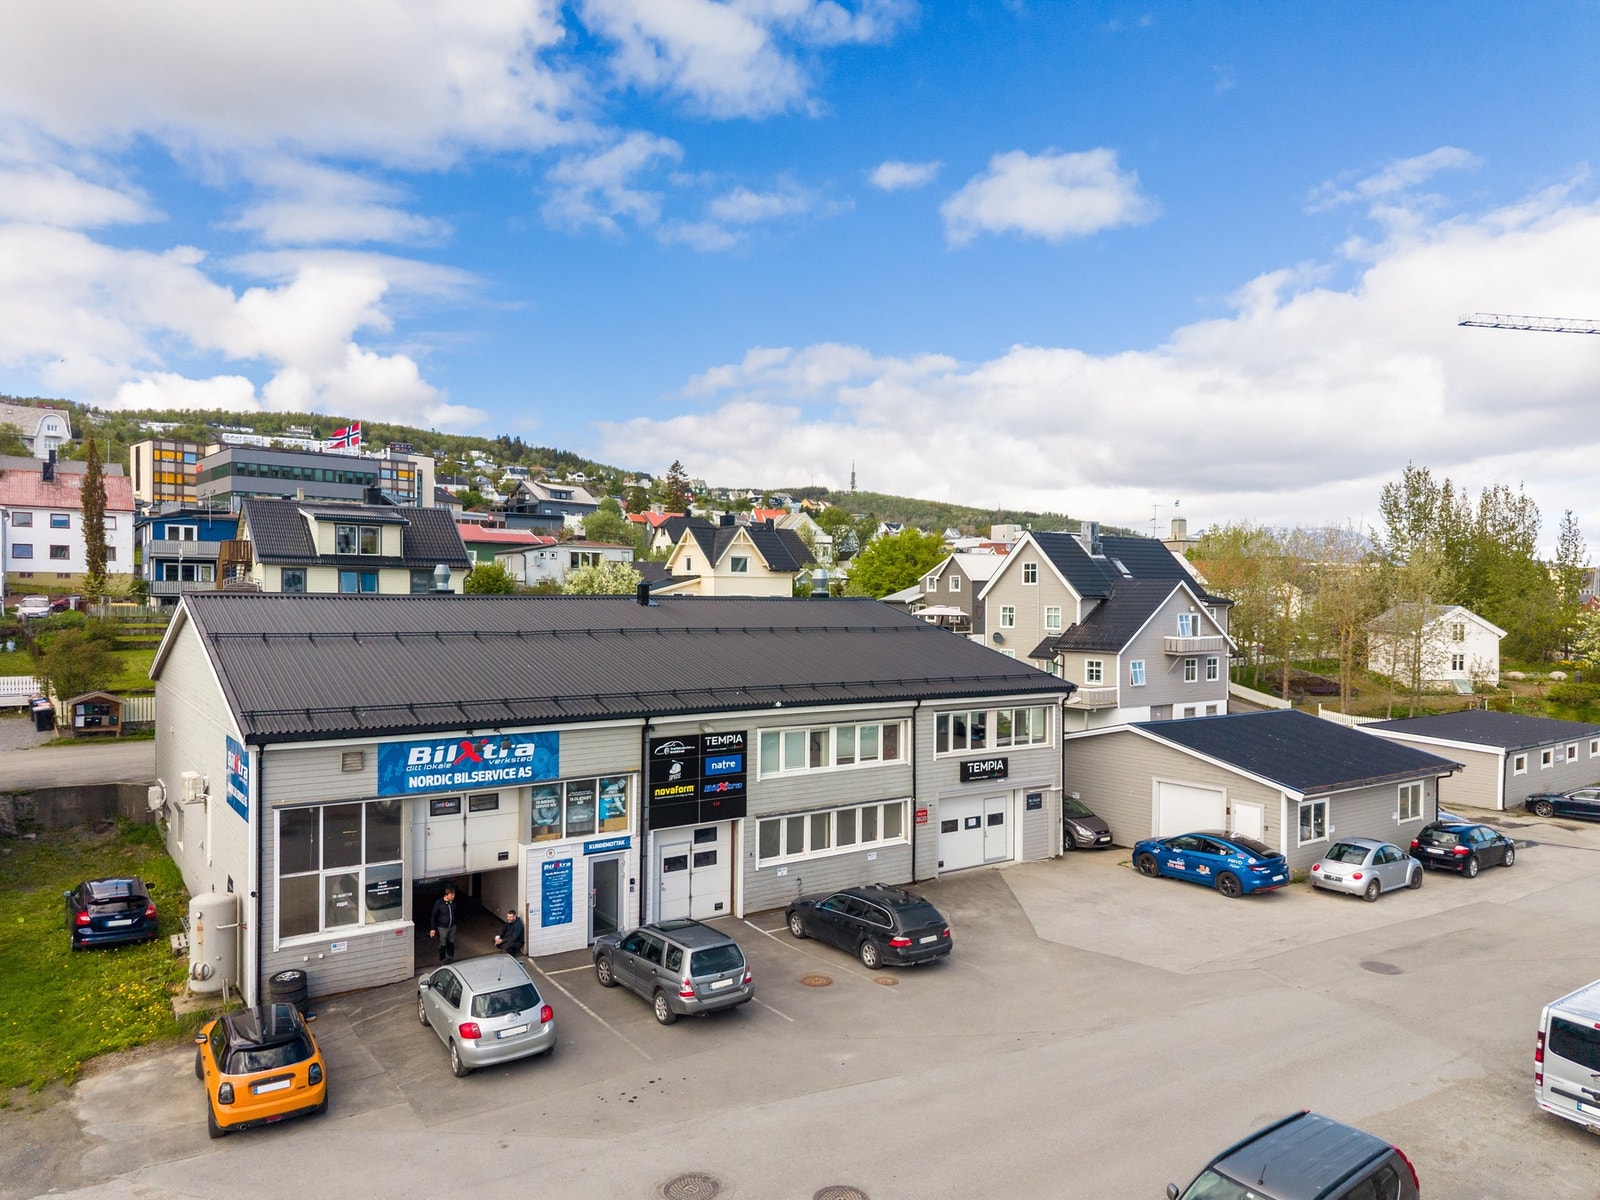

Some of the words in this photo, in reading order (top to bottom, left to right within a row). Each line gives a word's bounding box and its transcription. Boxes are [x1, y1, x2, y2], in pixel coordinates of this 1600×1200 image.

[704, 734, 743, 746] TEMPIA
[488, 755, 534, 766] verksted
[711, 760, 736, 770] natre
[406, 763, 422, 773] ditt
[423, 763, 453, 771] lokale
[967, 760, 1004, 773] TEMPIA
[408, 773, 452, 788] NORDIC
[454, 768, 517, 784] BILSERVICE
[517, 766, 533, 778] AS
[654, 785, 695, 796] novaform
[588, 840, 625, 850] KUNDEMOTTAK
